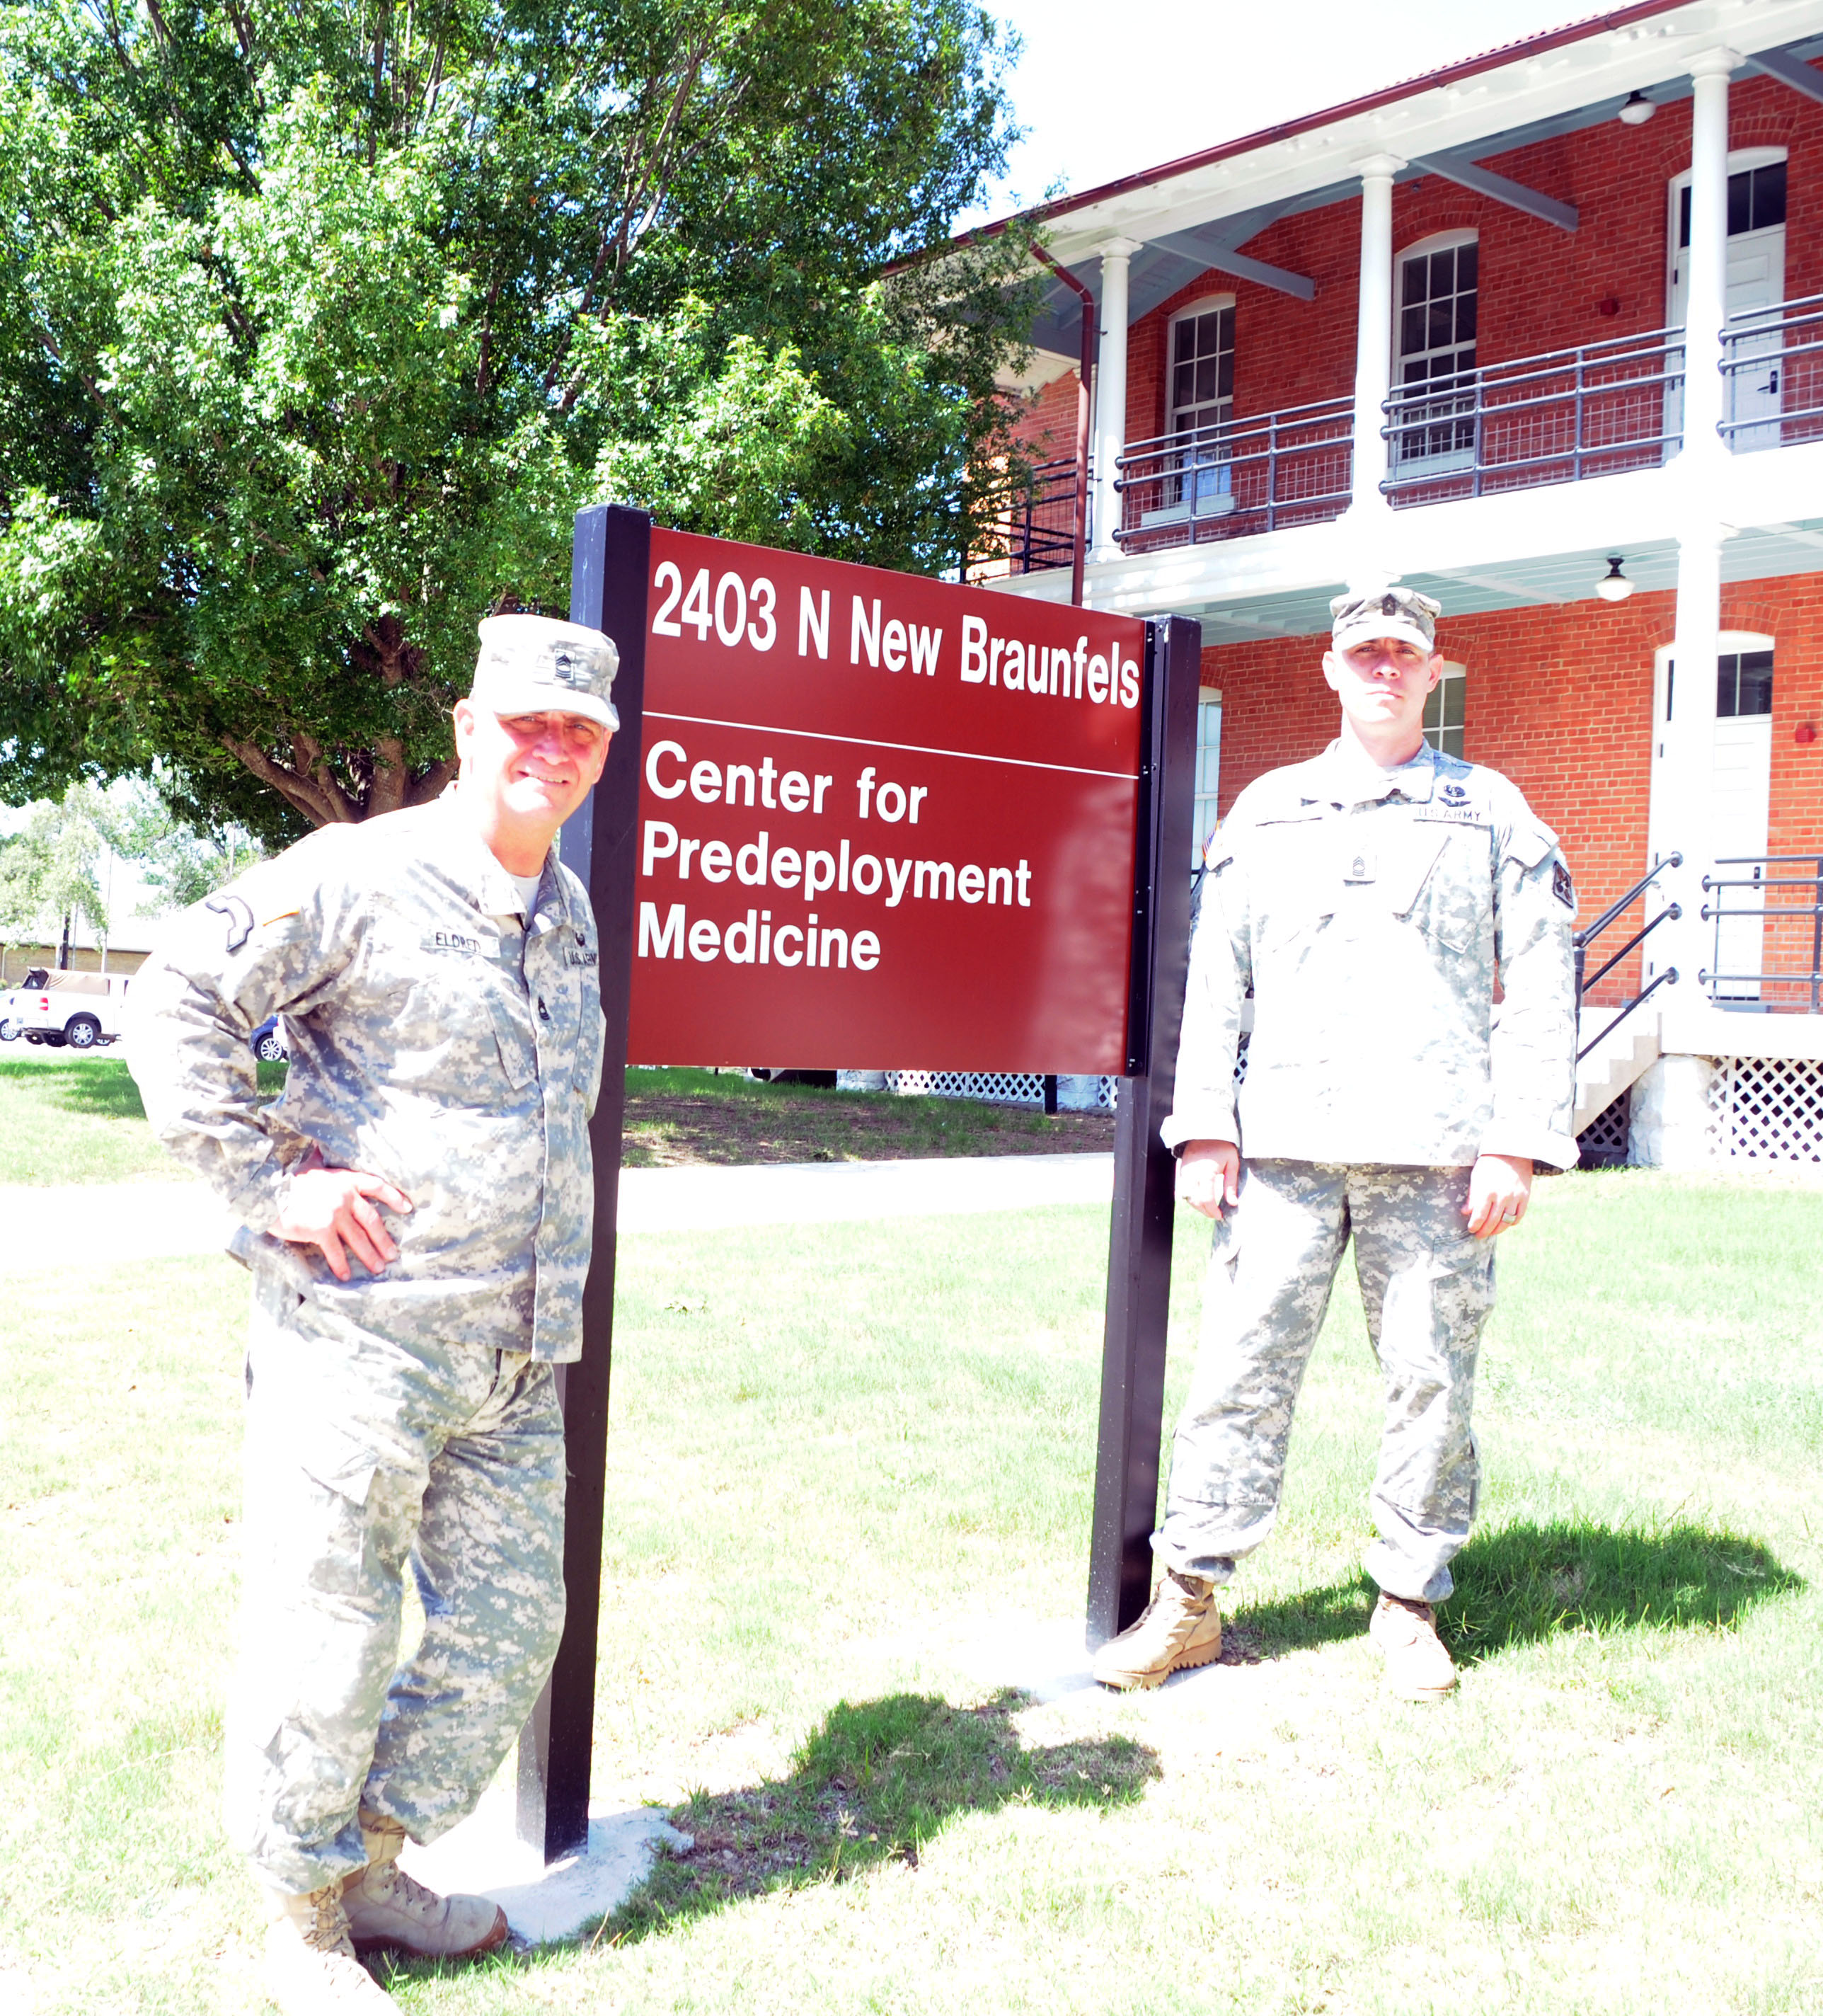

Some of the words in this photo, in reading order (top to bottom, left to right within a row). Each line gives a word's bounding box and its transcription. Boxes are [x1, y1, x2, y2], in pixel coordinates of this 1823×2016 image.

[652, 561, 777, 652] 2403
[798, 585, 831, 660] N
[850, 595, 943, 677] New
[960, 614, 1139, 709] Braunfels
[645, 740, 833, 814] Center
[856, 767, 928, 824] for
[1443, 809, 1481, 822] ARMY
[642, 820, 1032, 907] Predeployment
[436, 932, 481, 952] ELDRED
[638, 901, 881, 971] Medicine
